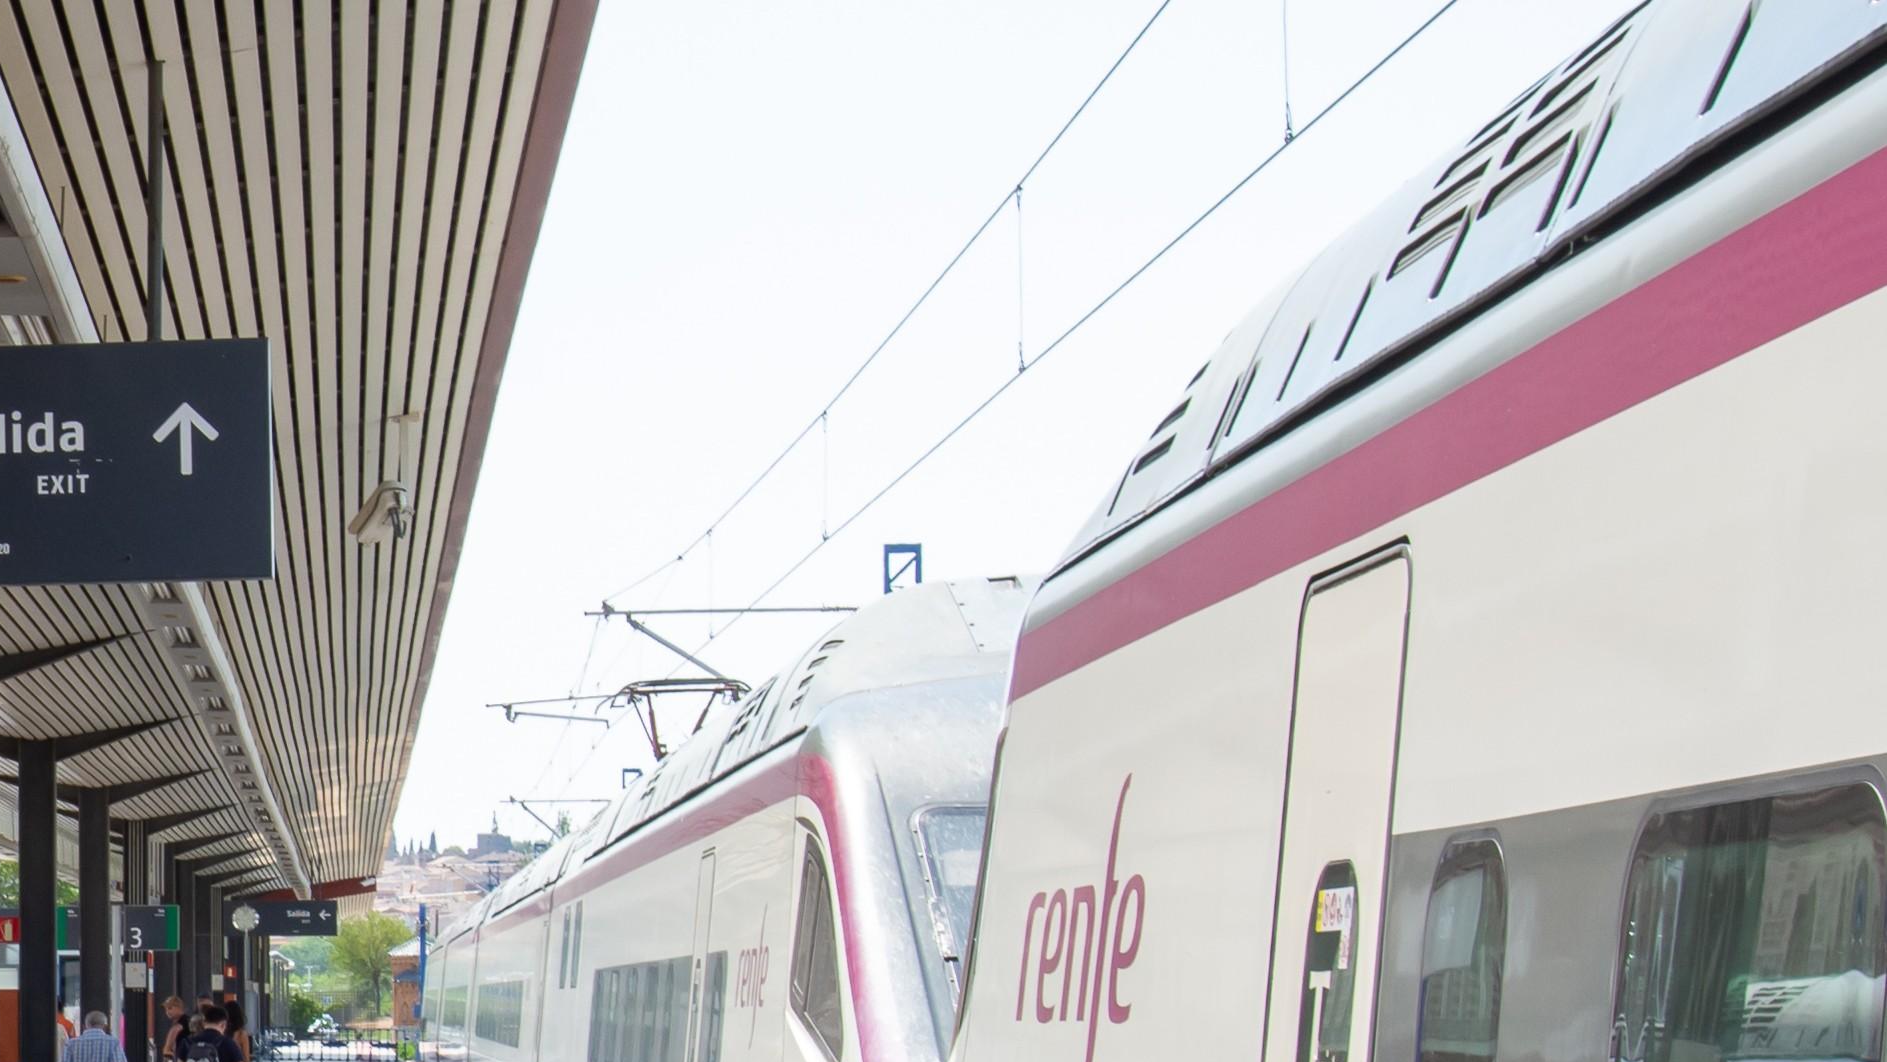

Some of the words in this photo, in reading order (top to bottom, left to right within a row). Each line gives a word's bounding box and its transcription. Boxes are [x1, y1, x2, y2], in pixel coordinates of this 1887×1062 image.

[37, 474, 90, 495] EXIT
[130, 927, 142, 948] 3
[734, 902, 770, 1051] renfe
